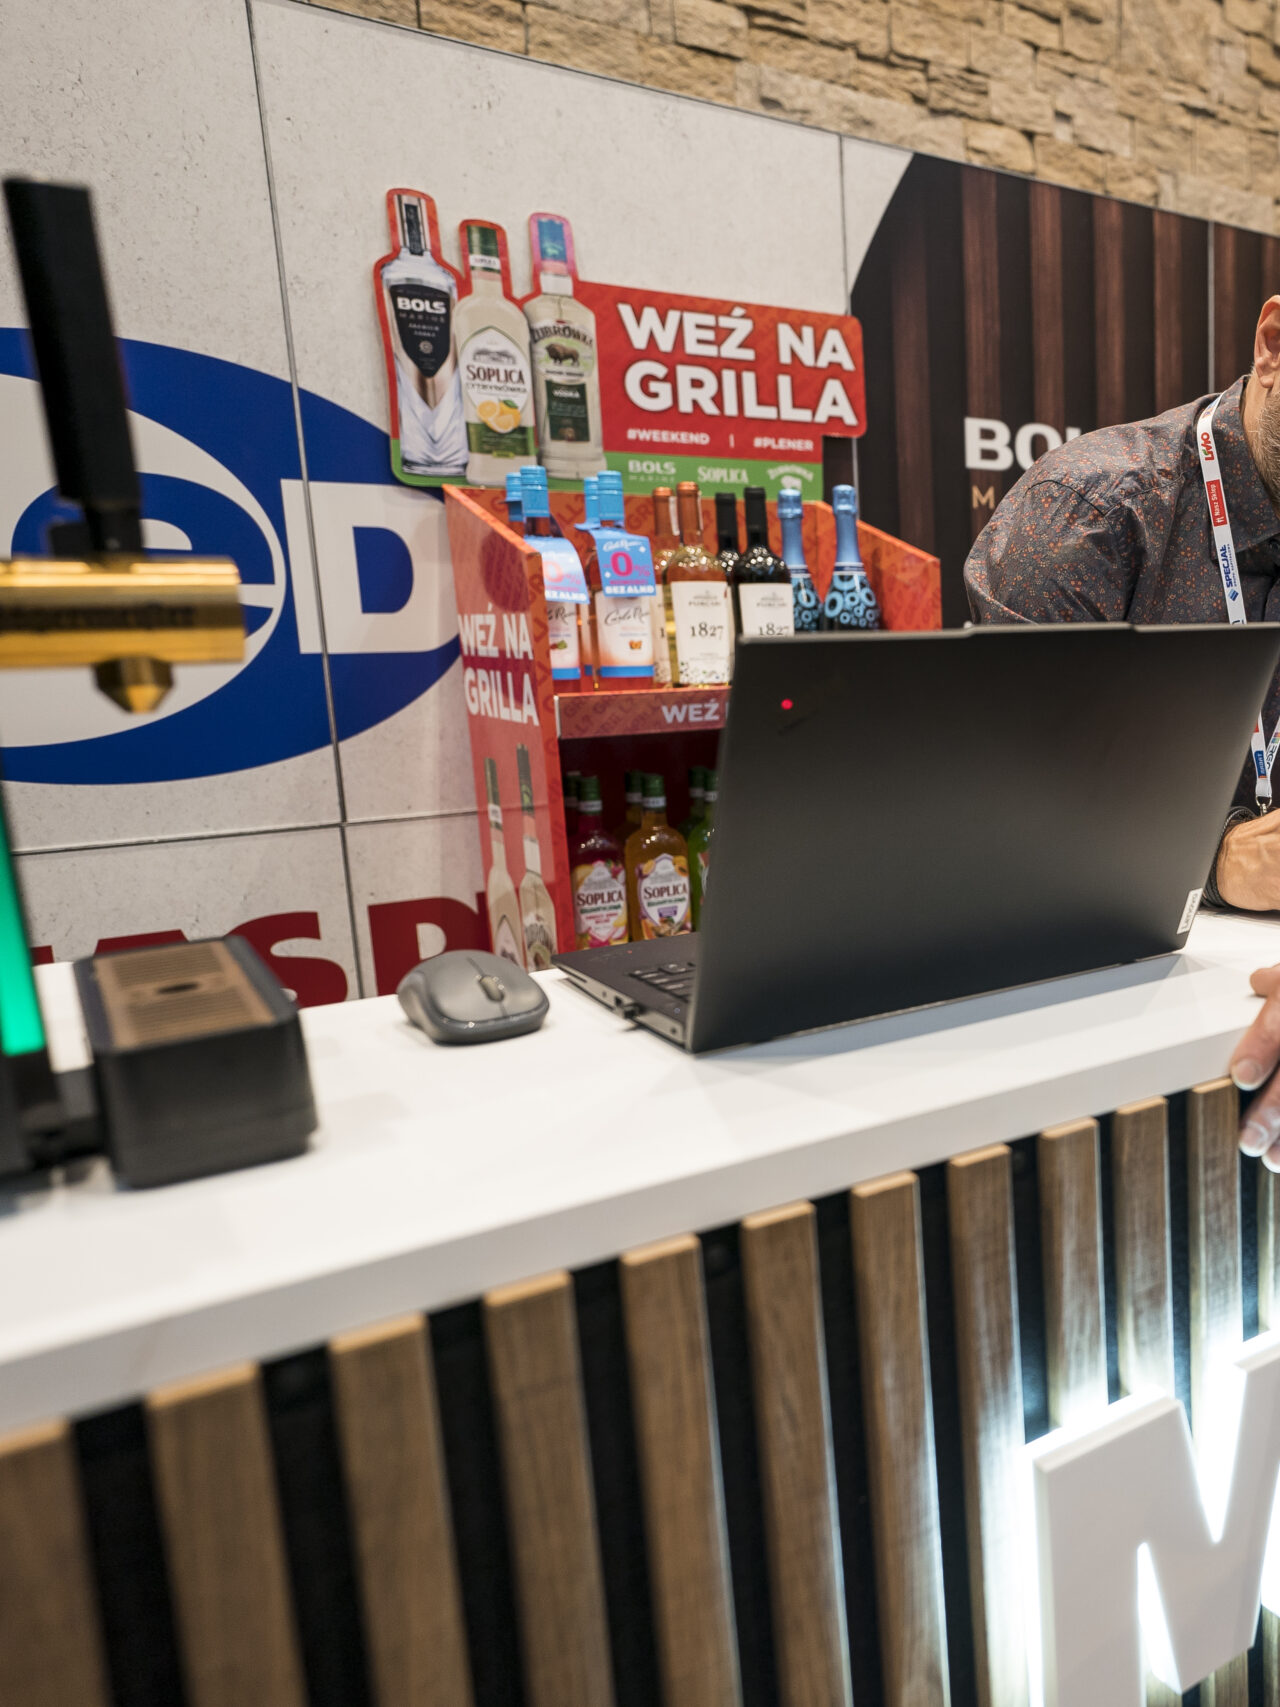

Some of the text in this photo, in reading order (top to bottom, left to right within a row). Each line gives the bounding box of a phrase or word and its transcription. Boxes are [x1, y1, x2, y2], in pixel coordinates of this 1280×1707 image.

[397, 297, 446, 314] BOLS
[617, 303, 856, 371] WEŹ NA
[466, 364, 525, 385] SOPLICA
[624, 359, 858, 426] GRILLA
[627, 428, 814, 452] #WEEKEND #PLENER
[964, 417, 1081, 471] BO
[628, 460, 676, 475] BOLS
[698, 465, 749, 485] SOPLICA
[1220, 544, 1233, 588] SPECJAŁ
[458, 603, 499, 658] WEŹ
[503, 613, 534, 660] NA
[690, 622, 724, 640] 1827
[759, 622, 790, 637] 1827
[464, 667, 540, 726] GRILLA
[661, 698, 720, 725] WEŹ
[576, 890, 623, 906] SOPLICA
[644, 882, 688, 900] SOPLICA
